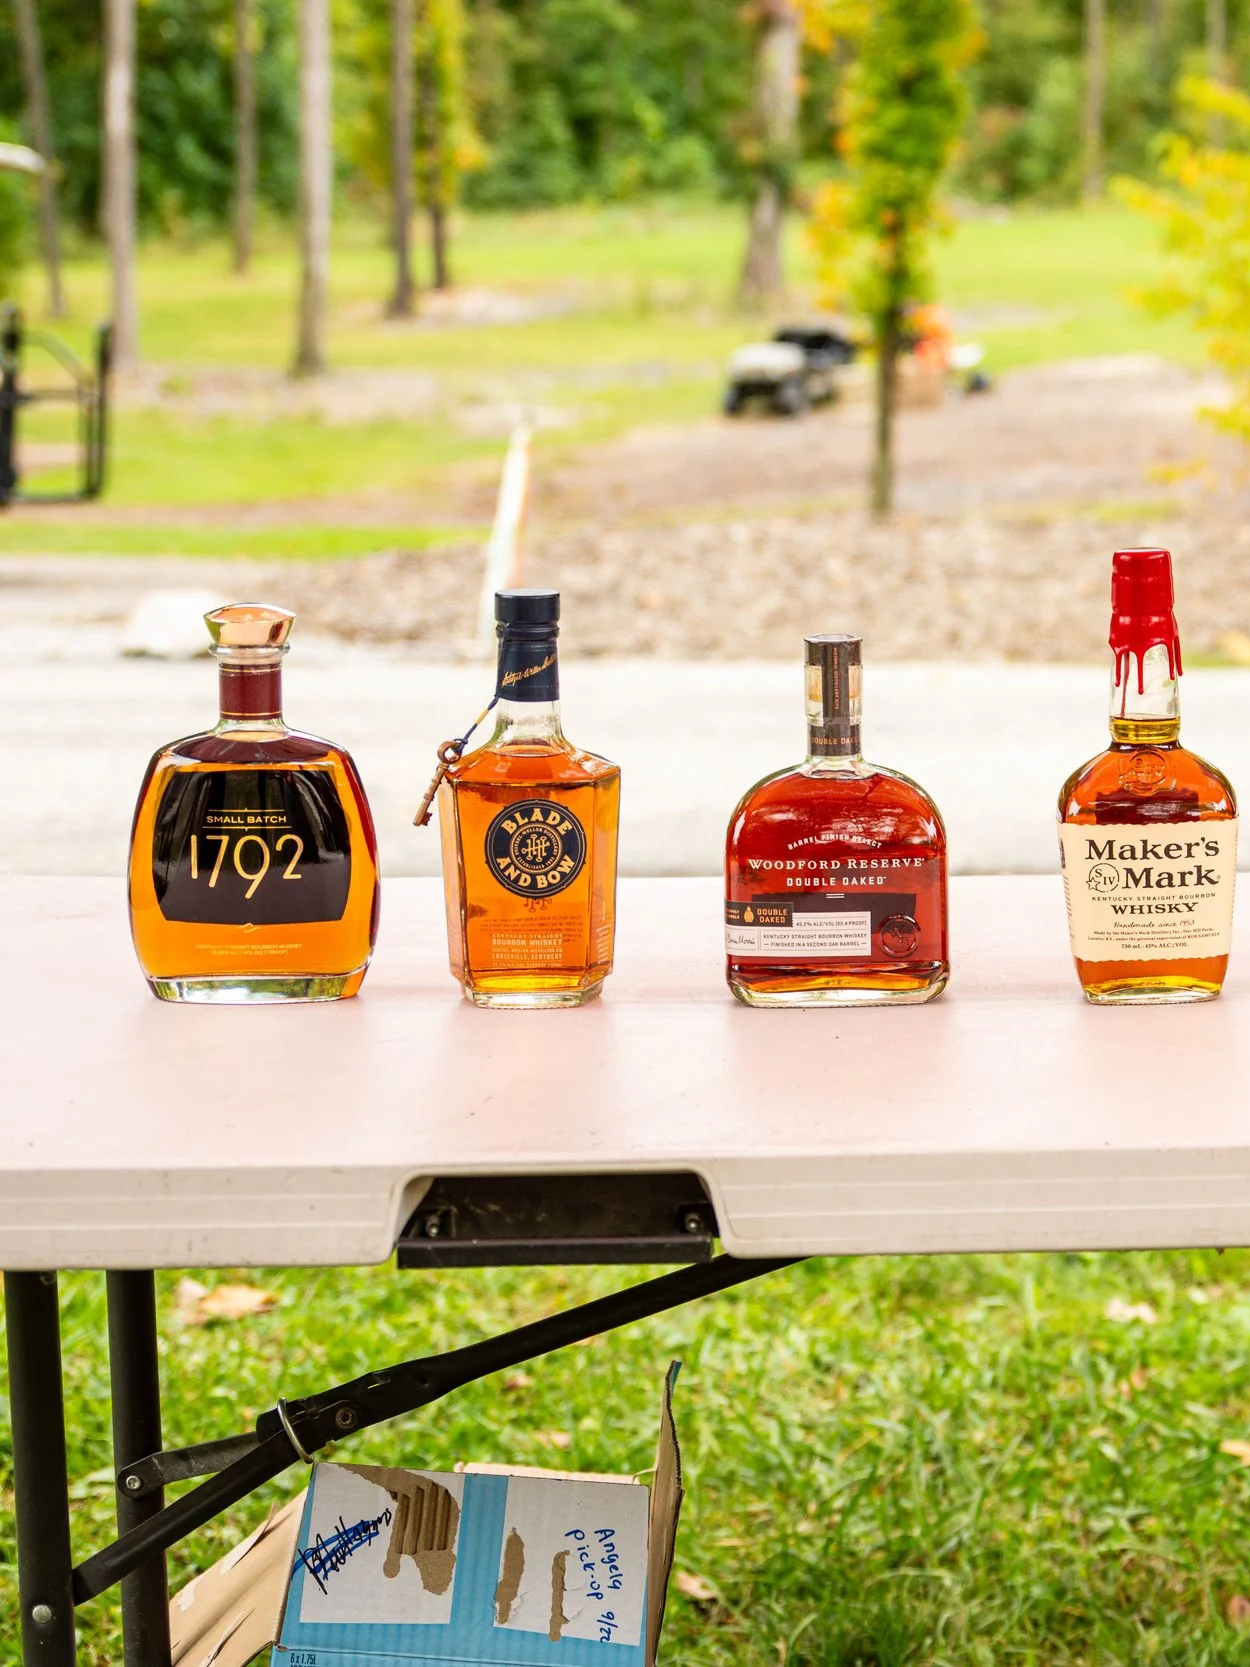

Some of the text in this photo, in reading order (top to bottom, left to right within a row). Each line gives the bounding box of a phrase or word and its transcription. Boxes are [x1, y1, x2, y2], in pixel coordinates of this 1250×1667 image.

[206, 815, 287, 824] SMALL BATCH
[501, 808, 573, 835] BLADE
[788, 833, 882, 850] BARREL FINISH SELECT
[1085, 837, 1220, 861] Maker's
[190, 834, 304, 899] 1792
[496, 854, 575, 888] AND BOW
[749, 858, 922, 870] WOODFORD RESERVE
[786, 876, 883, 887] DOUBLE OAKED
[1122, 864, 1219, 889] Mark
[757, 908, 788, 916] DOUBLE
[1110, 902, 1199, 915] WHISKY
[759, 916, 786, 924] OAKED
[597, 1611, 618, 1643] 9/22
[290, 1652, 316, 1665] 6 x 1.75L
